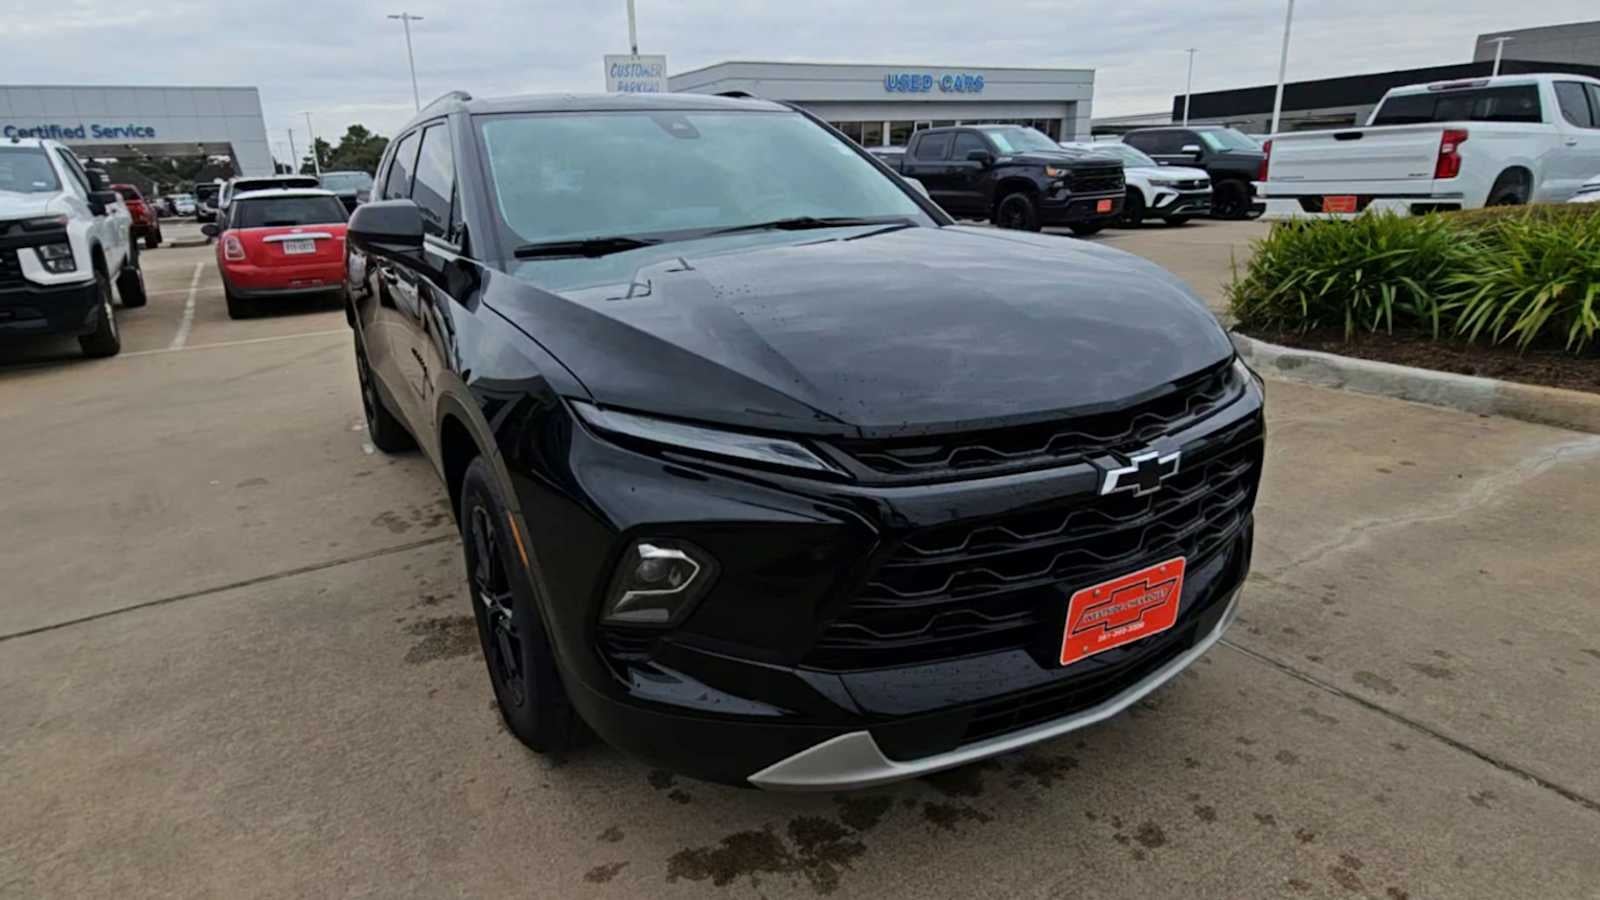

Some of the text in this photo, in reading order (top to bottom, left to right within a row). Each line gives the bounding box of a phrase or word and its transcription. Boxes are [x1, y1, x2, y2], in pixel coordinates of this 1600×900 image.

[610, 63, 662, 78] CUSTOMER
[884, 74, 984, 93] USED CARS
[4, 123, 156, 139] Certified Service
